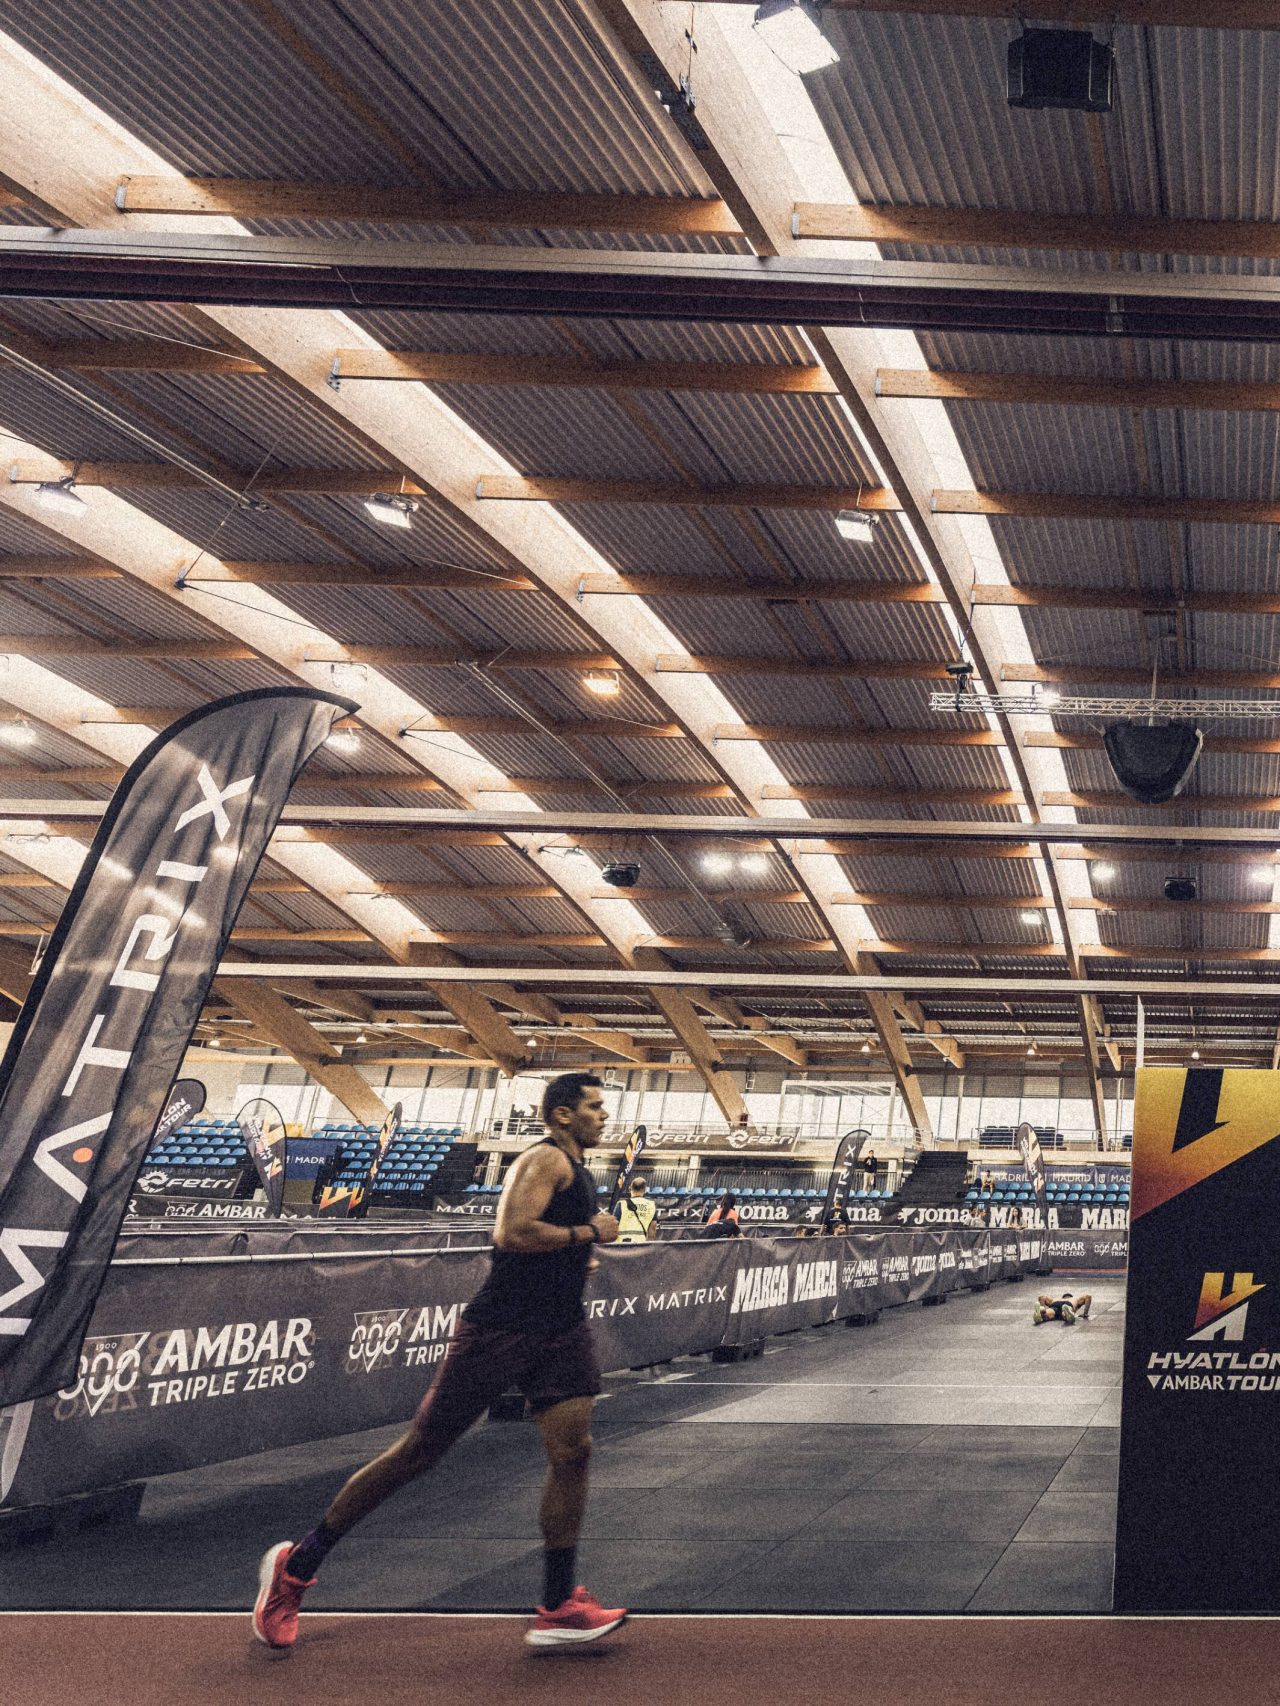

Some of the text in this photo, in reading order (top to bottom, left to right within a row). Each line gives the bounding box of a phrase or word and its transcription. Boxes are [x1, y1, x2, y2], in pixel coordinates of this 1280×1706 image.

[0, 763, 256, 1336] MATRIX
[198, 1204, 267, 1218] AMBAR
[436, 1205, 493, 1214] MATR
[656, 1209, 702, 1217] TRIX
[1048, 1242, 1084, 1251] AMBAR
[730, 1265, 789, 1314] MARCA
[793, 1261, 837, 1303] MARCA
[648, 1286, 727, 1312] MATRIX
[151, 1317, 313, 1376] AMBAR
[147, 1371, 239, 1406] TRIPLE
[1162, 1375, 1225, 1390] AMBAR
